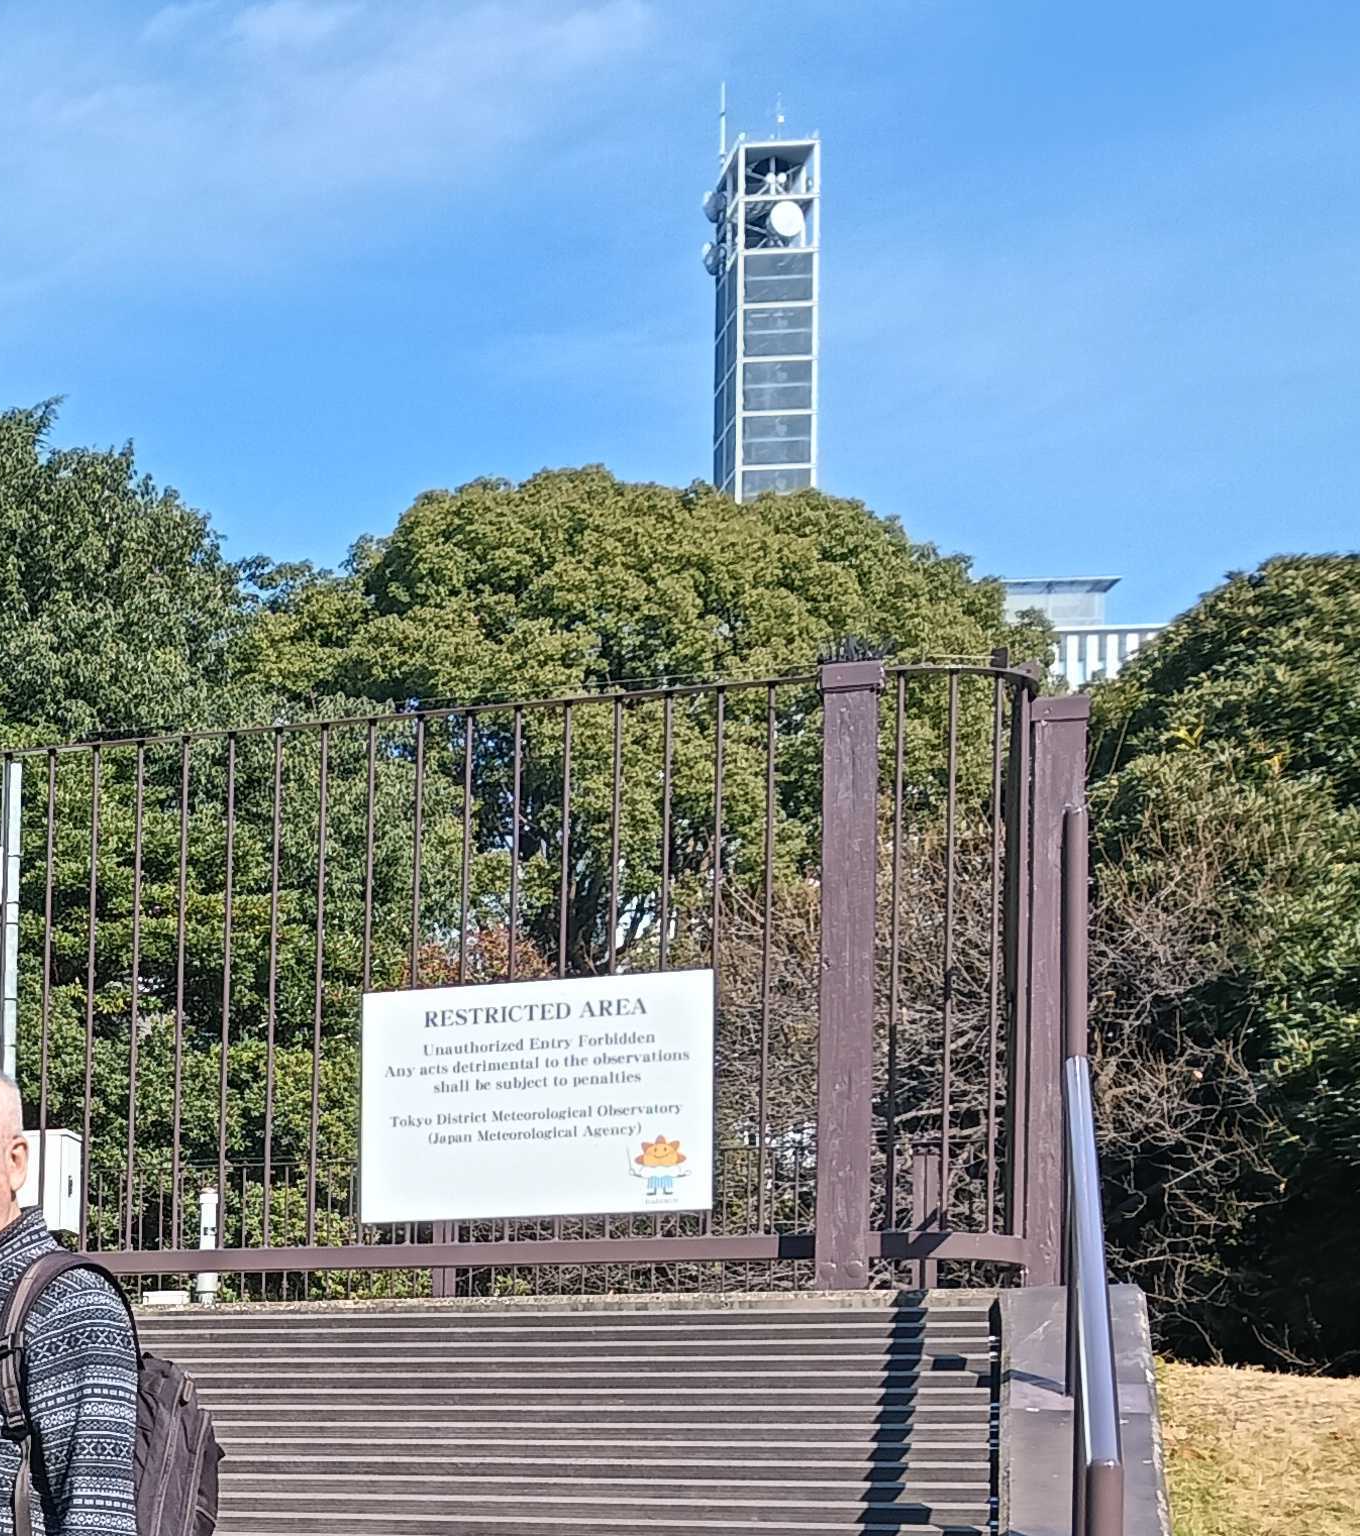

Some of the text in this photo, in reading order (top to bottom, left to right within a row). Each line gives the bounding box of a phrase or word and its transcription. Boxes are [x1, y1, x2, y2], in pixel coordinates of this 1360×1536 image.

[424, 997, 647, 1028] RESTRICTED AREA
[423, 1032, 656, 1056] Unauthorized Entry Forbidden
[384, 1049, 690, 1078] Any acts detrimental to the observations
[433, 1070, 641, 1093] shall be subject to penalties
[390, 1103, 682, 1128] Tokyo District Meteorological Observatory
[428, 1122, 642, 1145] (Japan Meteorological Agency)
